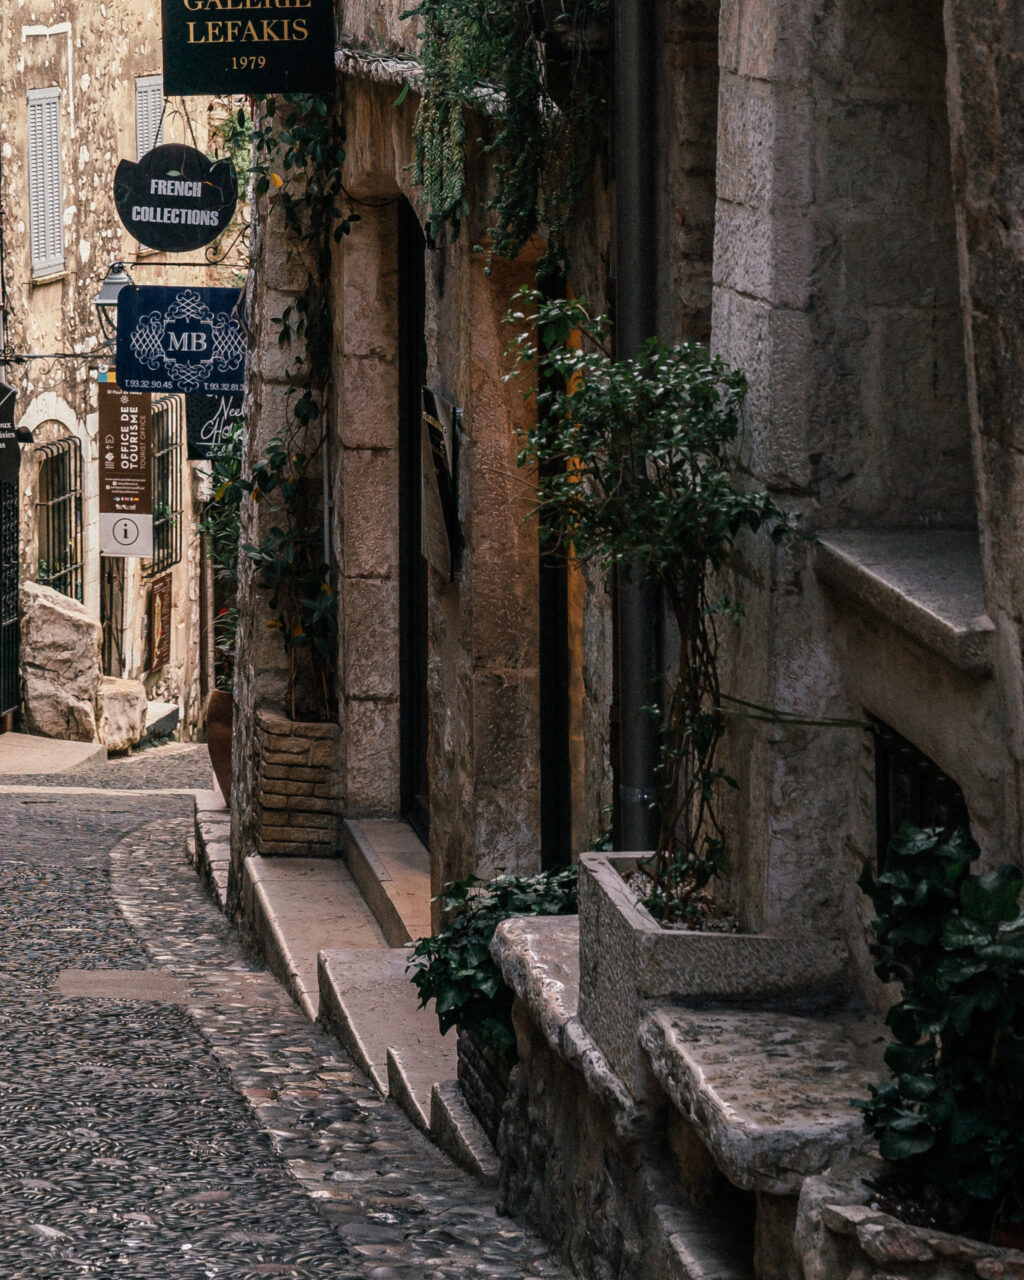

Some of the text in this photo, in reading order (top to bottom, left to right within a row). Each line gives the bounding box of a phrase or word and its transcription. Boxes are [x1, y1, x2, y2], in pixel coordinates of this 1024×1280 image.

[186, 18, 309, 44] LEFAKIS
[231, 55, 266, 70] 1979
[150, 178, 202, 198] FRENCH
[131, 205, 219, 227] COLLECTIONS
[167, 331, 207, 352] MB
[120, 406, 130, 470] OFFICE DE
[129, 406, 139, 470] TOURISME
[139, 415, 147, 440] OFFICE
